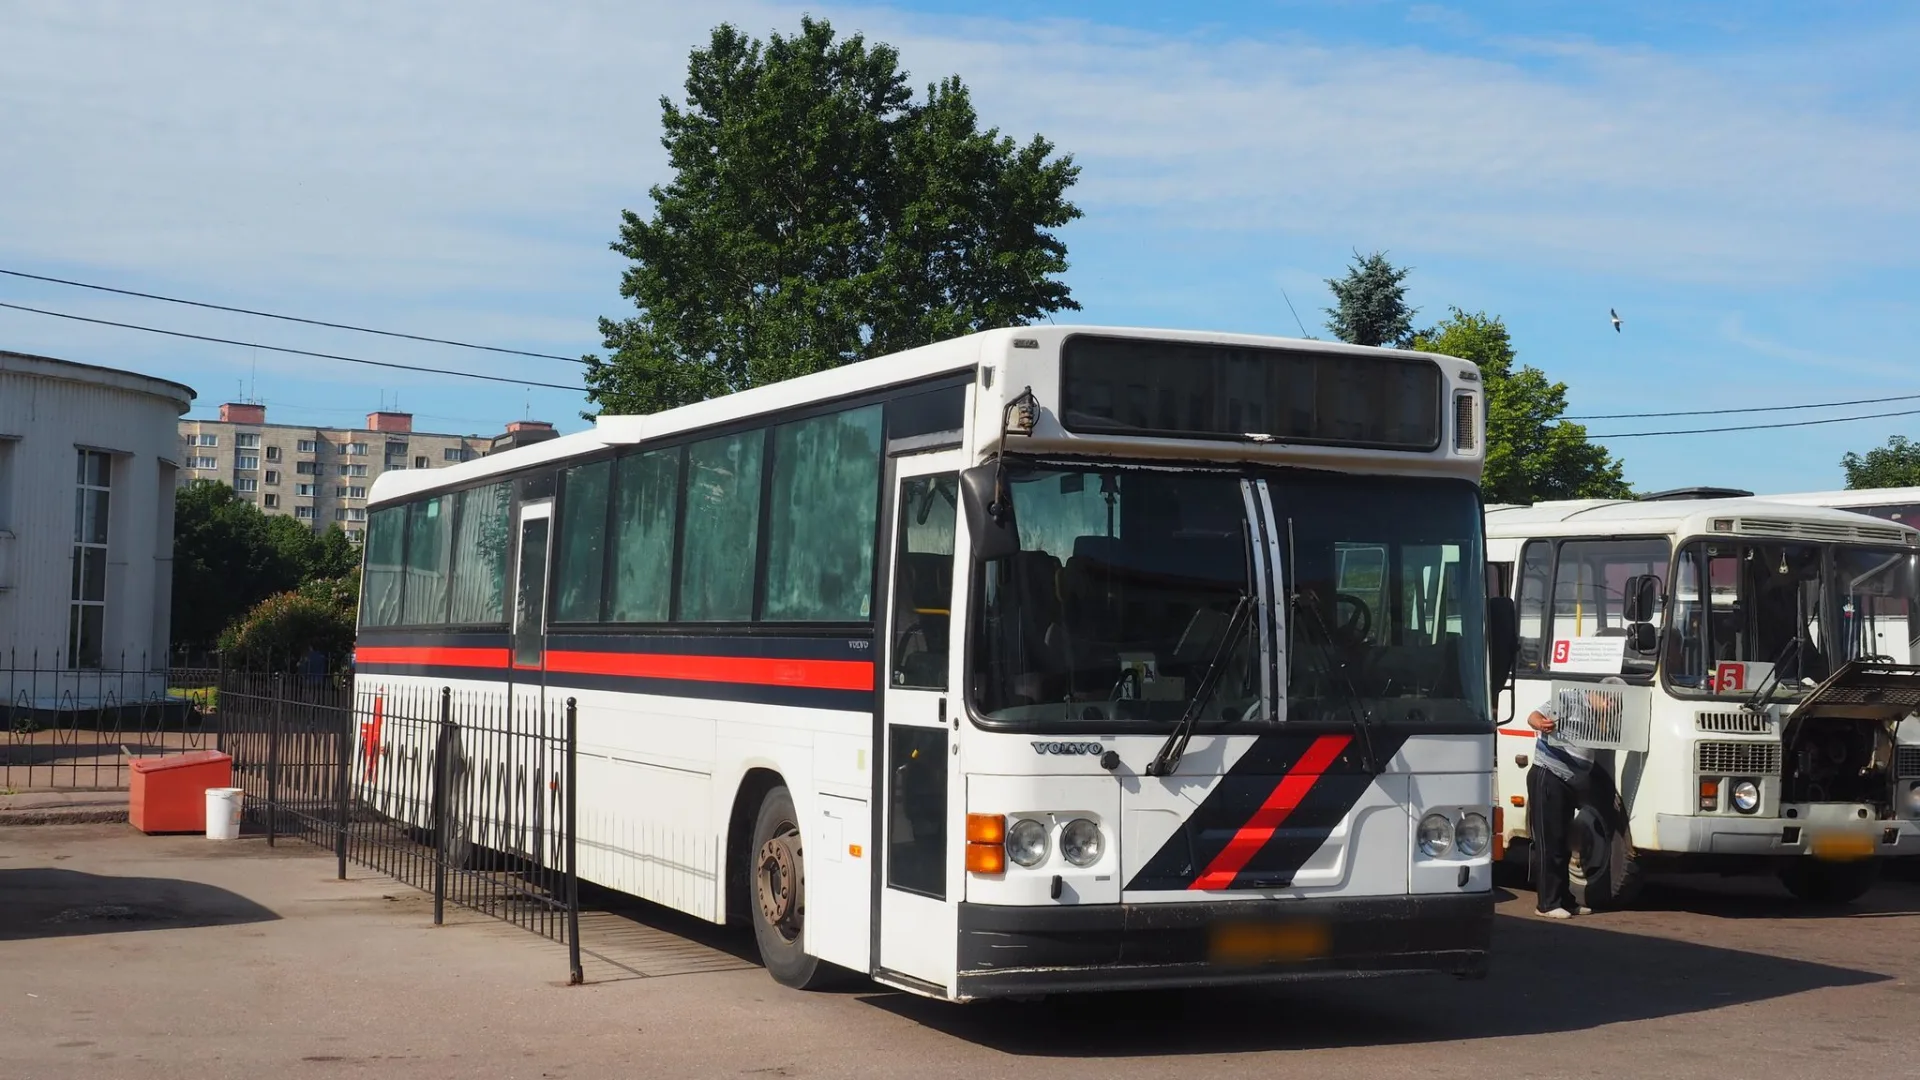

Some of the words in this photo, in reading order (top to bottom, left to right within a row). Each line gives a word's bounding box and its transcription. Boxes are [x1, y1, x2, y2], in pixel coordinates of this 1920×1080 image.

[1555, 643, 1566, 660] 5
[1722, 668, 1737, 691] 5
[1030, 741, 1103, 755] VOLVO
